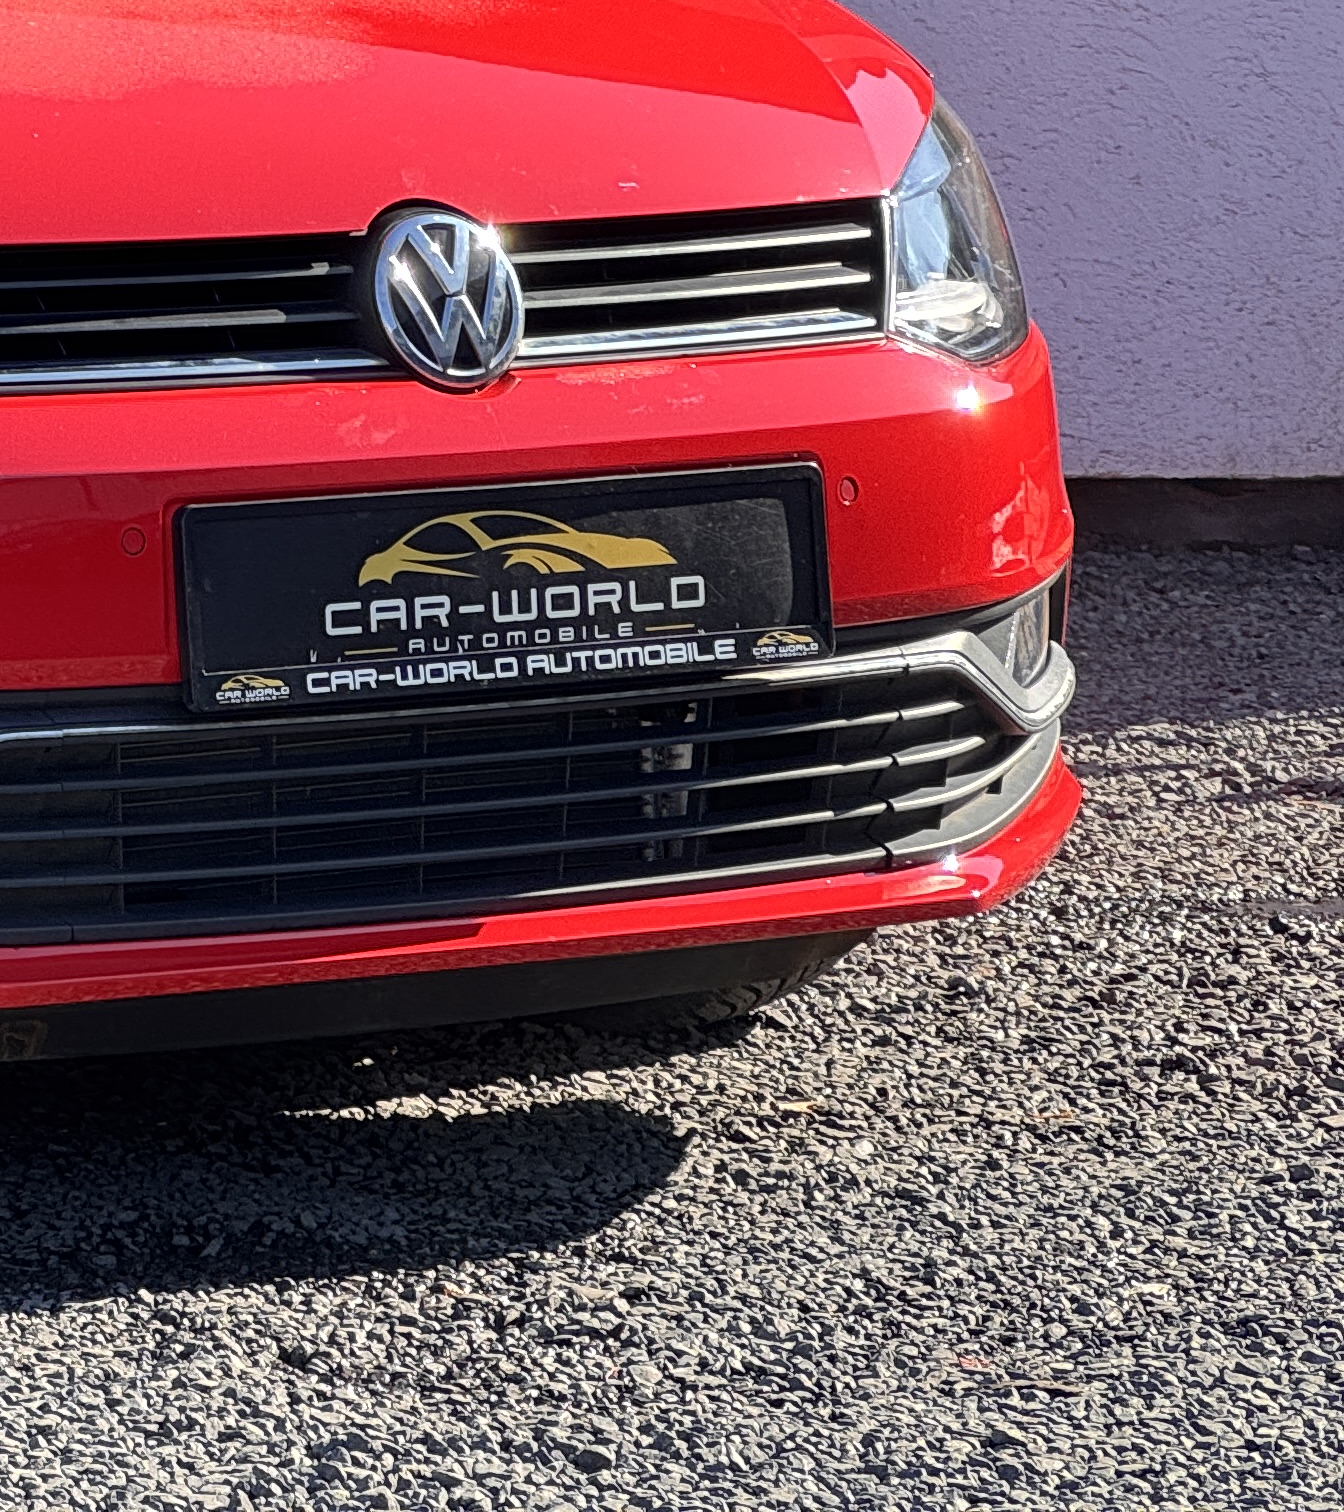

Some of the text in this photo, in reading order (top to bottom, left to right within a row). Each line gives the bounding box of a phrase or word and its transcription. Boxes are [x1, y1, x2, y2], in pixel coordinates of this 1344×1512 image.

[325, 575, 706, 636] CAR-WORLD
[306, 638, 738, 694] CAR-WORLD AUTOMOBILE
[408, 622, 634, 655] AUTOMOBILE
